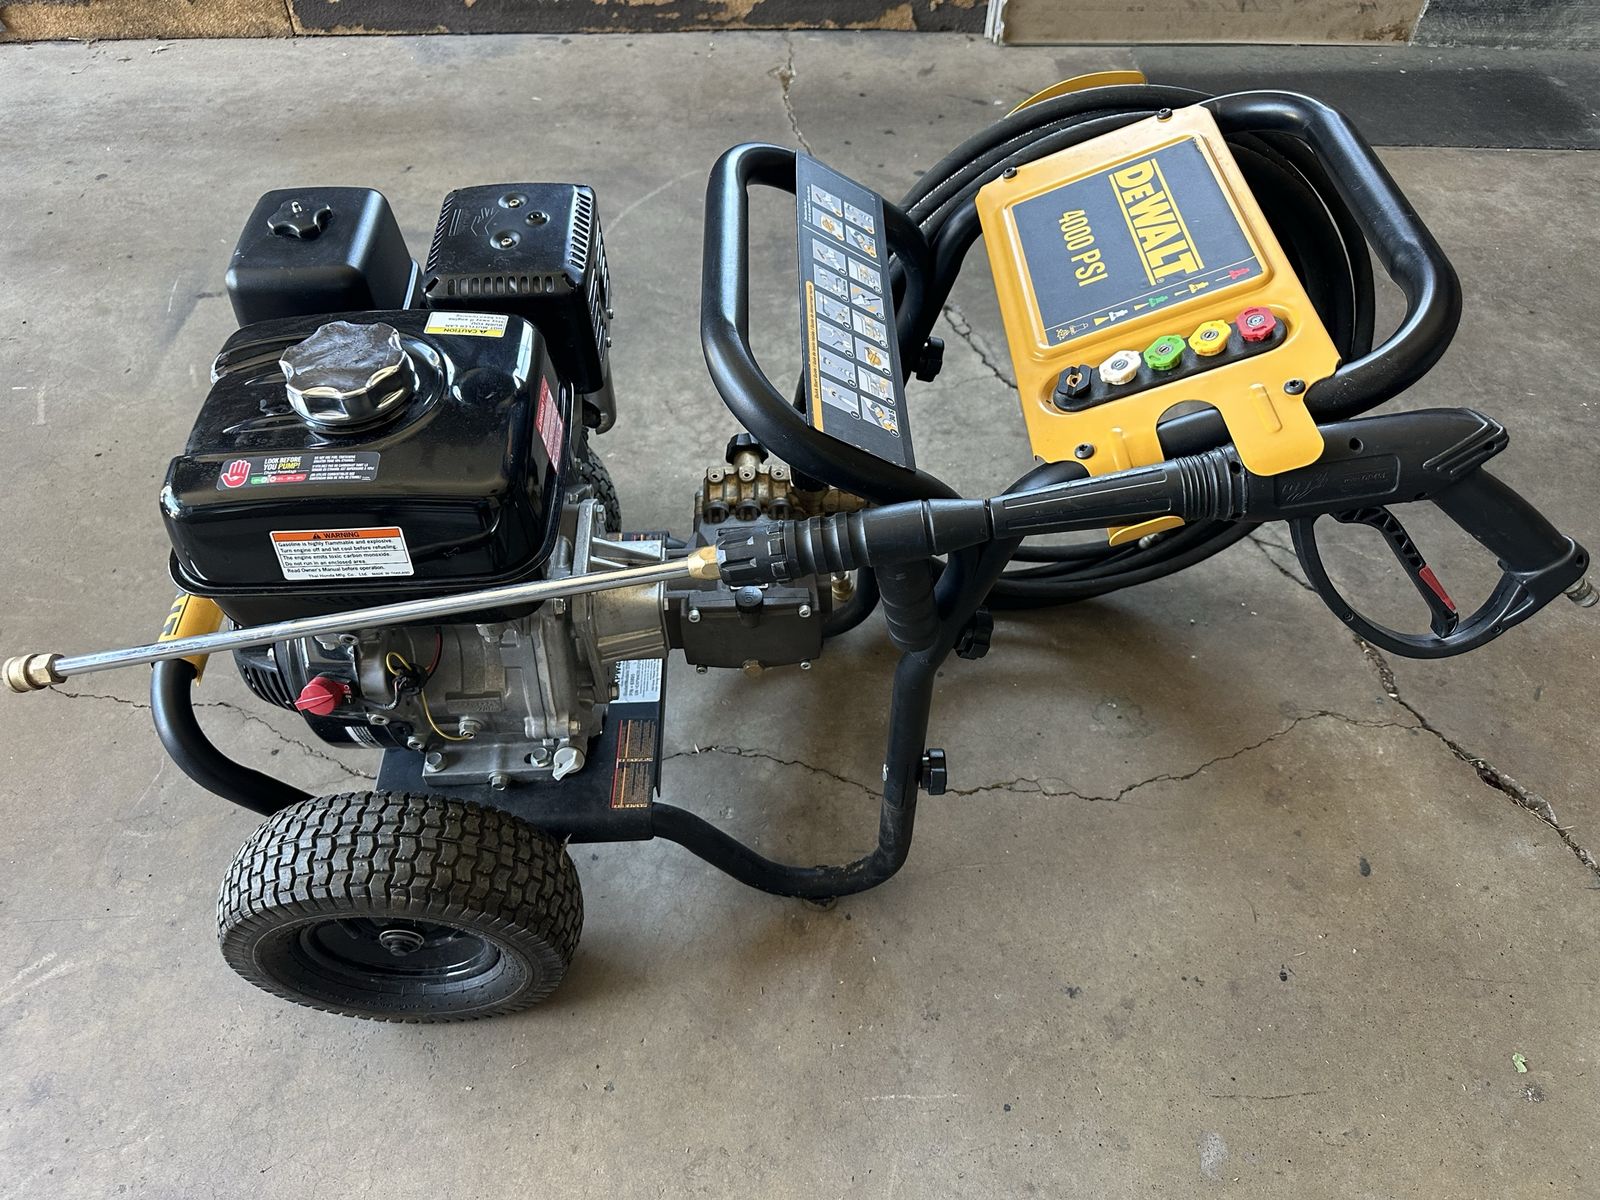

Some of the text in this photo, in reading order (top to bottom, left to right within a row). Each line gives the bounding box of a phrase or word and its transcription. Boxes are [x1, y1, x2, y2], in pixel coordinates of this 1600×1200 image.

[1058, 209, 1109, 287] 4000 PSI
[1115, 160, 1201, 280] DEWALT
[744, 590, 755, 604] OIL
